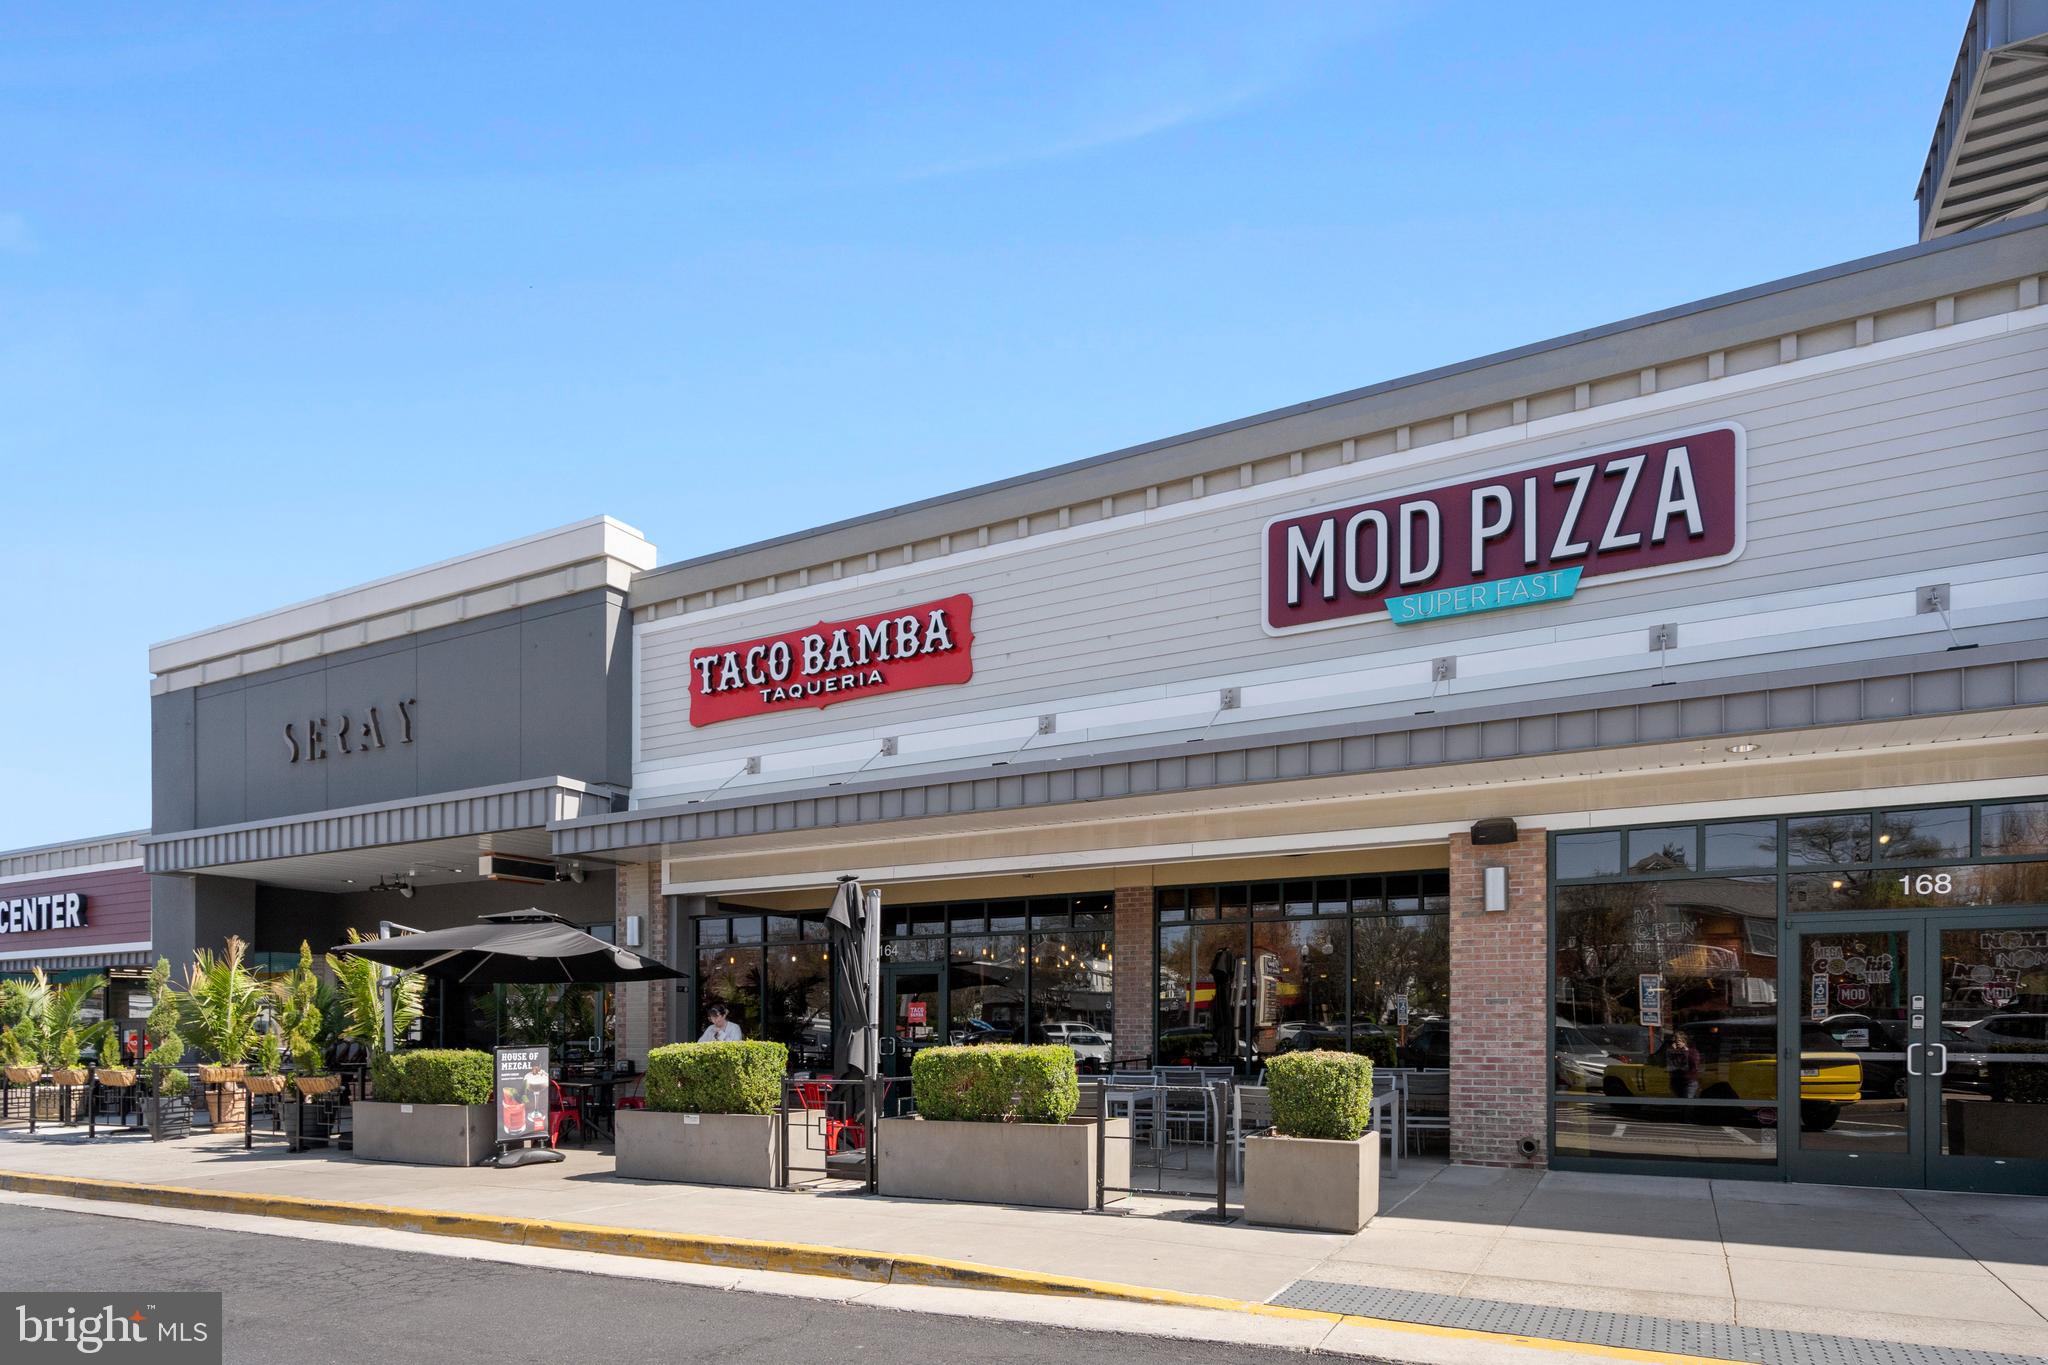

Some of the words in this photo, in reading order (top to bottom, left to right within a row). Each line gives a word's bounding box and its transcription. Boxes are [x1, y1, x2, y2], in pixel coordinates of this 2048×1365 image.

[1287, 499, 1441, 608] MOD
[1471, 446, 1704, 576] PIZZA
[1401, 584, 1487, 620] SUPER
[1497, 572, 1564, 603] FAST
[693, 640, 793, 694] TACO
[800, 609, 954, 677] BAMBA
[760, 670, 884, 703] TAQUERIA
[283, 698, 417, 764] SERAY
[1898, 873, 1952, 895] 168
[0, 892, 82, 934] CENTER
[1841, 988, 1866, 1002] MOD
[501, 1052, 527, 1062] HOUSE
[528, 1052, 539, 1061] OF
[501, 1062, 533, 1071] MEZCAL
